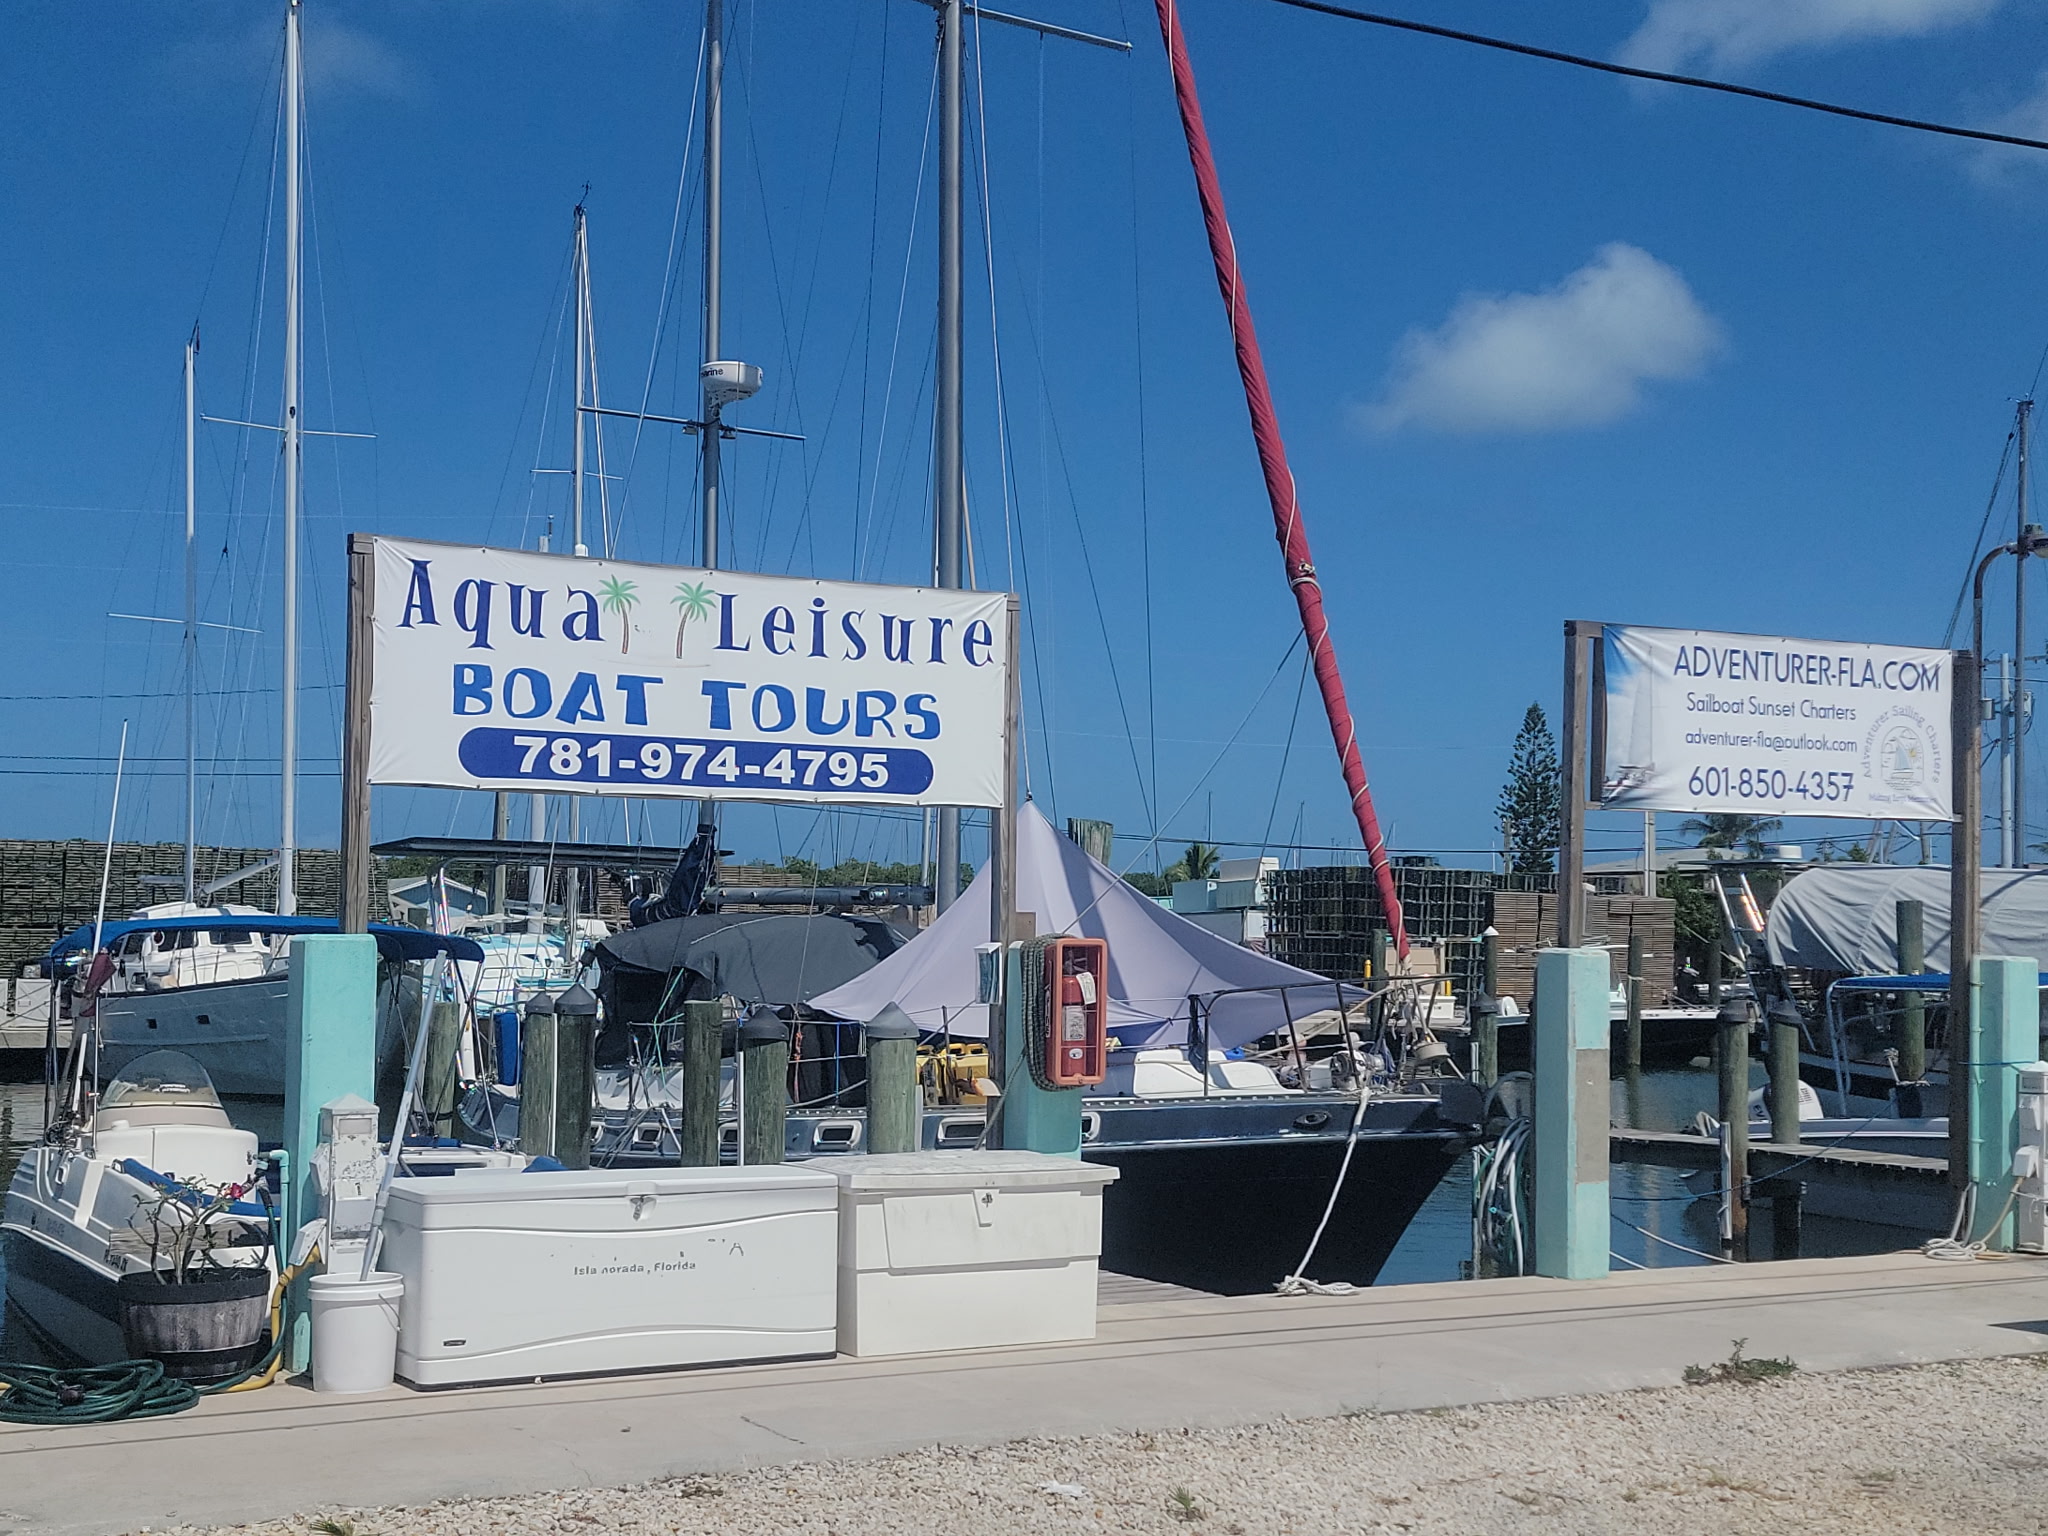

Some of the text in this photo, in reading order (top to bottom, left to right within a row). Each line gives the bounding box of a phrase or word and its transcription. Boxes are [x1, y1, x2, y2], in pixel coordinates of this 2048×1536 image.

[397, 558, 996, 667] Aqua Leisure
[1673, 645, 1941, 692] ADVENTURER-FLA.COM
[452, 663, 942, 741] BOAT TOURS
[1686, 692, 1857, 721] Sailboat Sunset Charters
[1685, 728, 1858, 753] adventurer-fla@outlook.com
[512, 736, 889, 788] 781-974-4795
[1688, 765, 1855, 802] 601-850-4357
[574, 1265, 597, 1276] Isla
[654, 1261, 696, 1272] Florida
